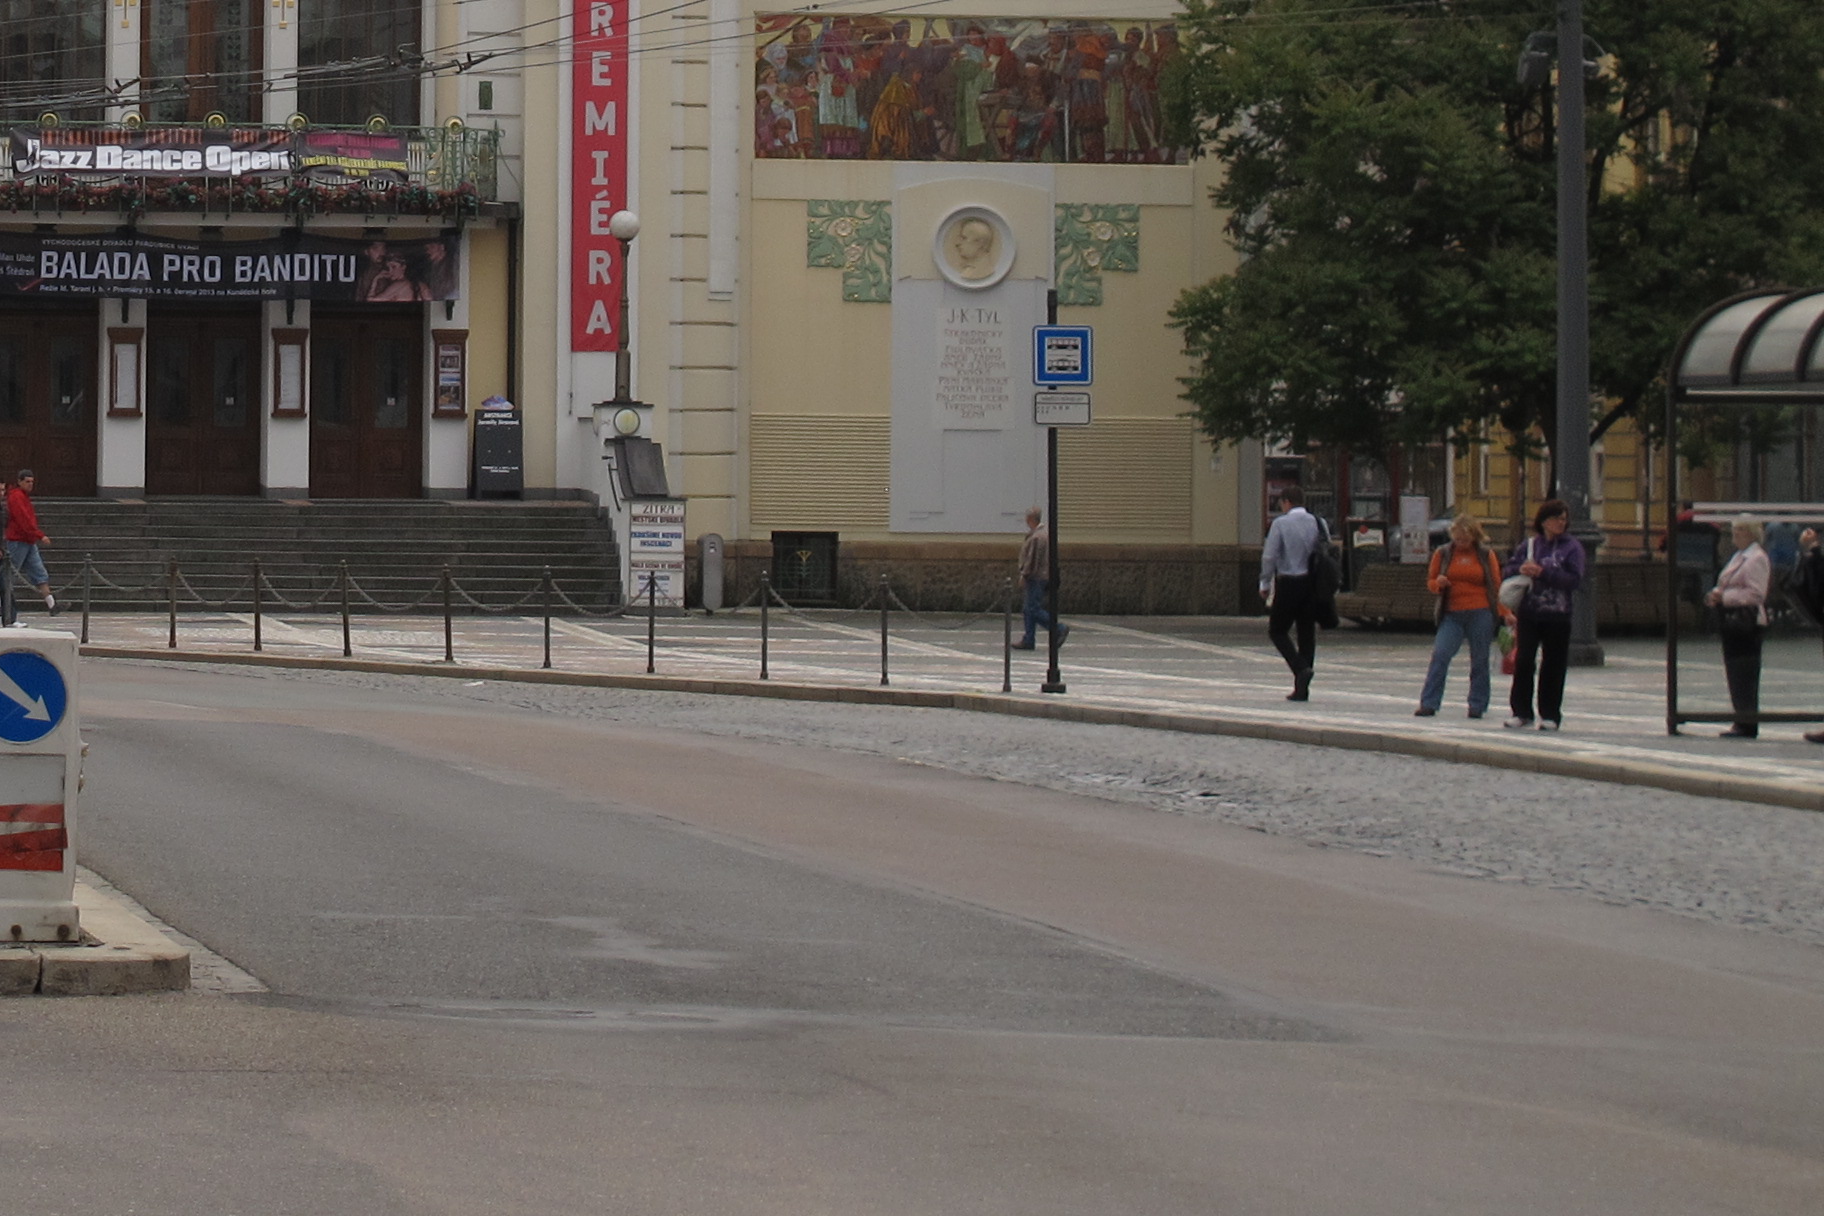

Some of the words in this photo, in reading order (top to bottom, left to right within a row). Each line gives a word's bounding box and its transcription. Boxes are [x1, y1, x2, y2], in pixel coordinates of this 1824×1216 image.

[15, 138, 94, 173] Jazz
[95, 145, 203, 171] Dance
[205, 145, 291, 176] Open
[40, 250, 152, 282] BALADA
[162, 253, 223, 283] PRO
[234, 253, 357, 284] BANDITU
